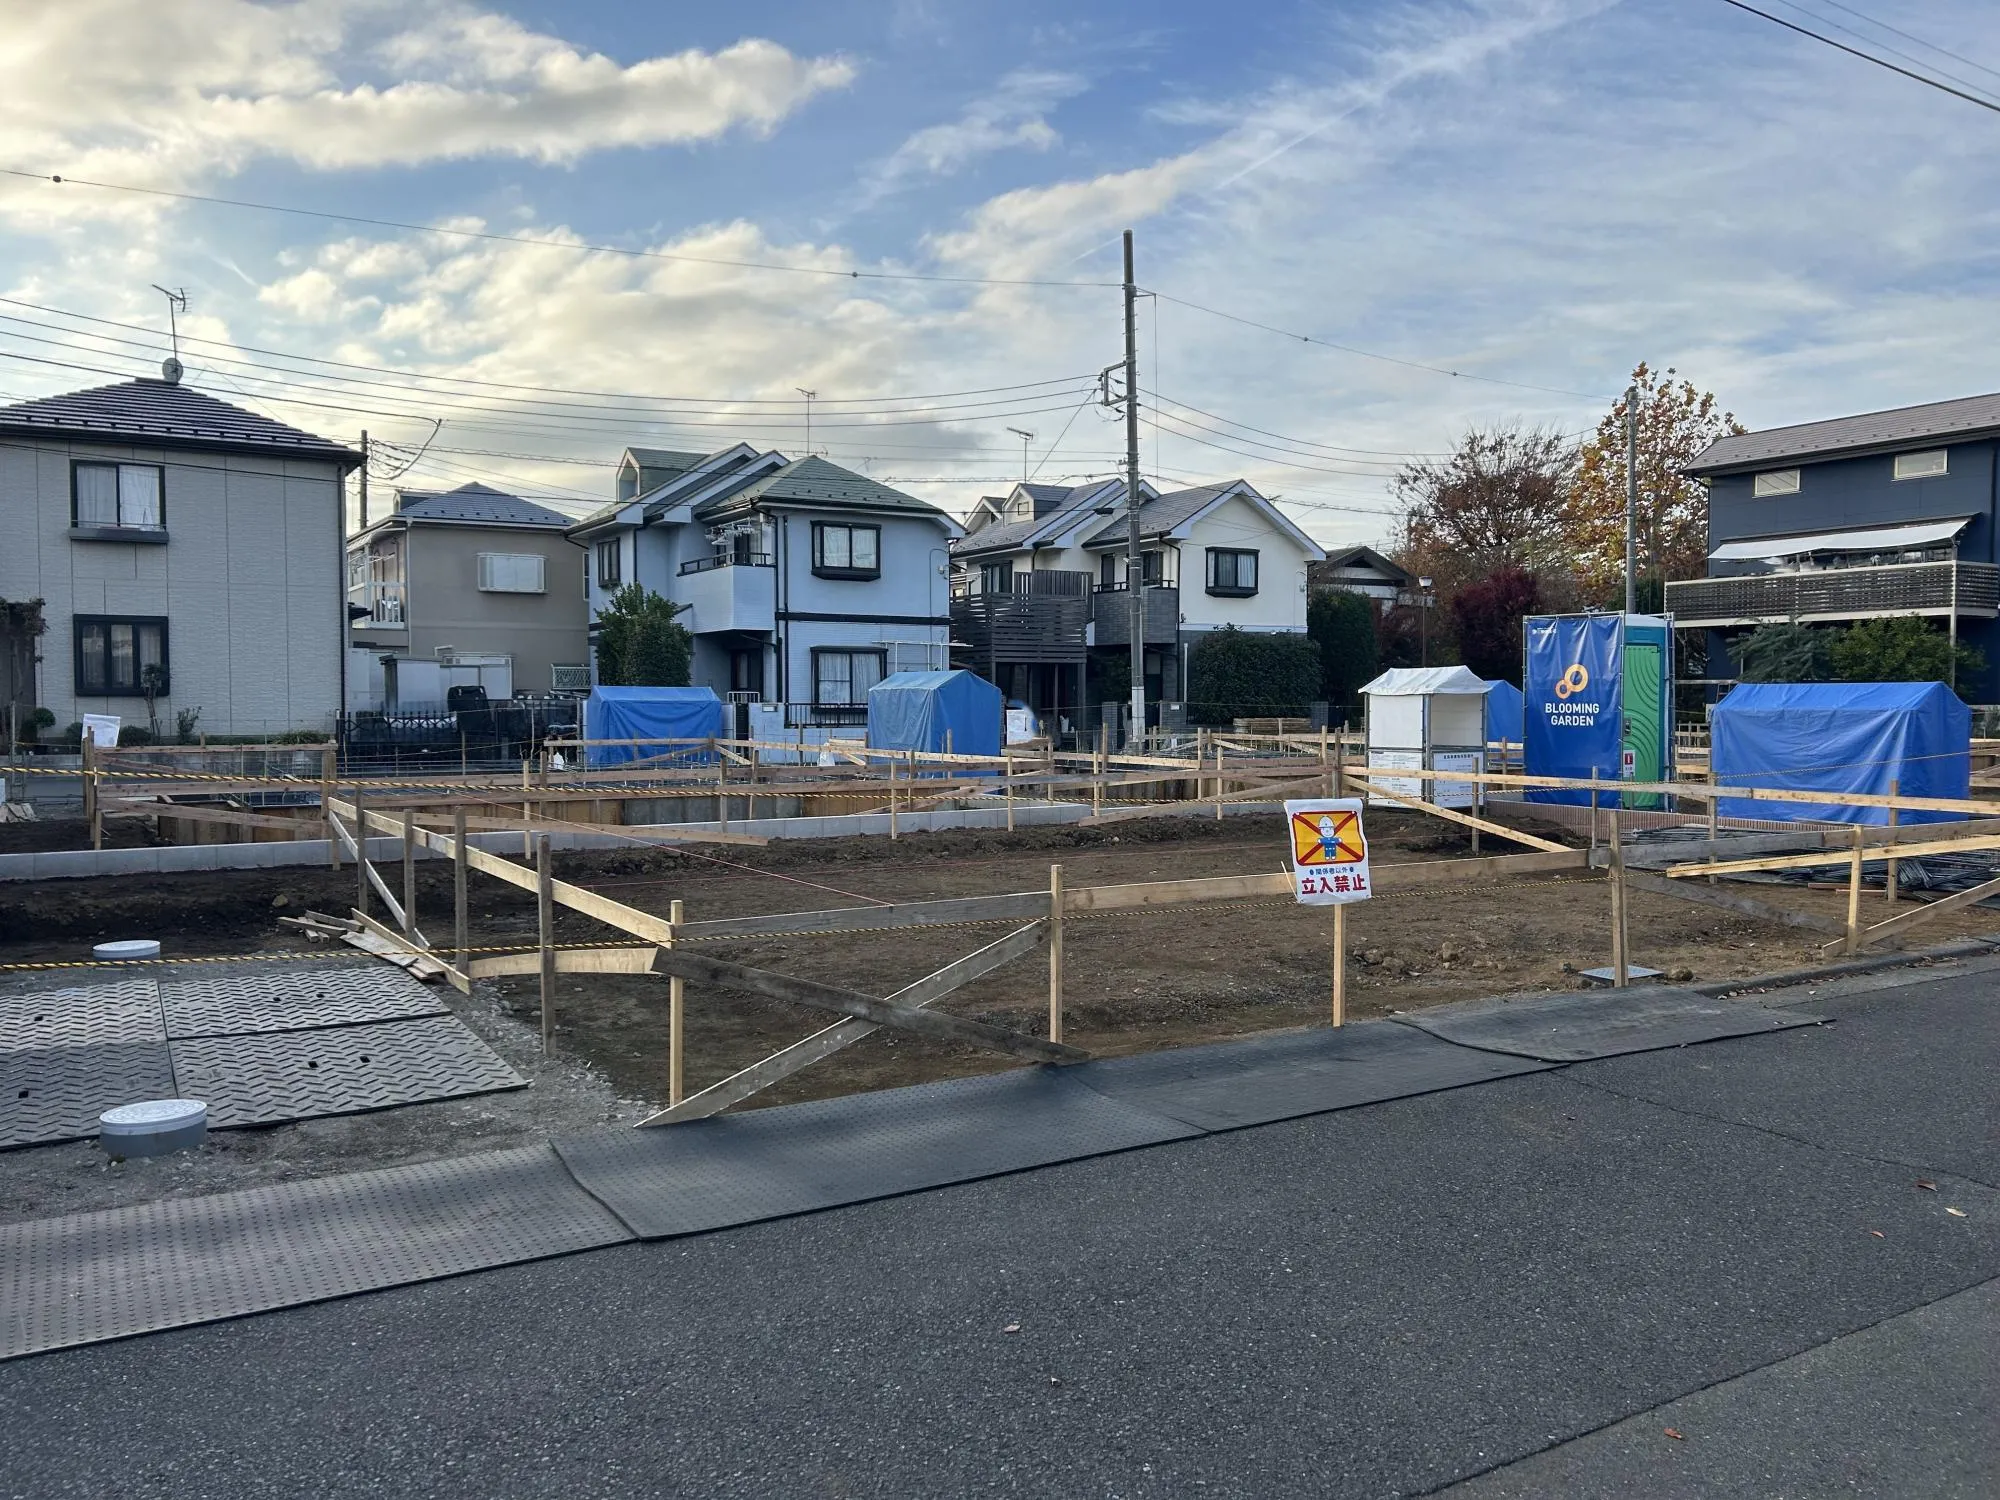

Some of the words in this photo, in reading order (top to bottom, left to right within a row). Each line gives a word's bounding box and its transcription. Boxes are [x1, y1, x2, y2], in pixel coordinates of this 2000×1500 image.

[1545, 702, 1600, 714] BLOOMING
[1551, 715, 1594, 727] GARDEN
[1301, 874, 1367, 894] 立入禁止
